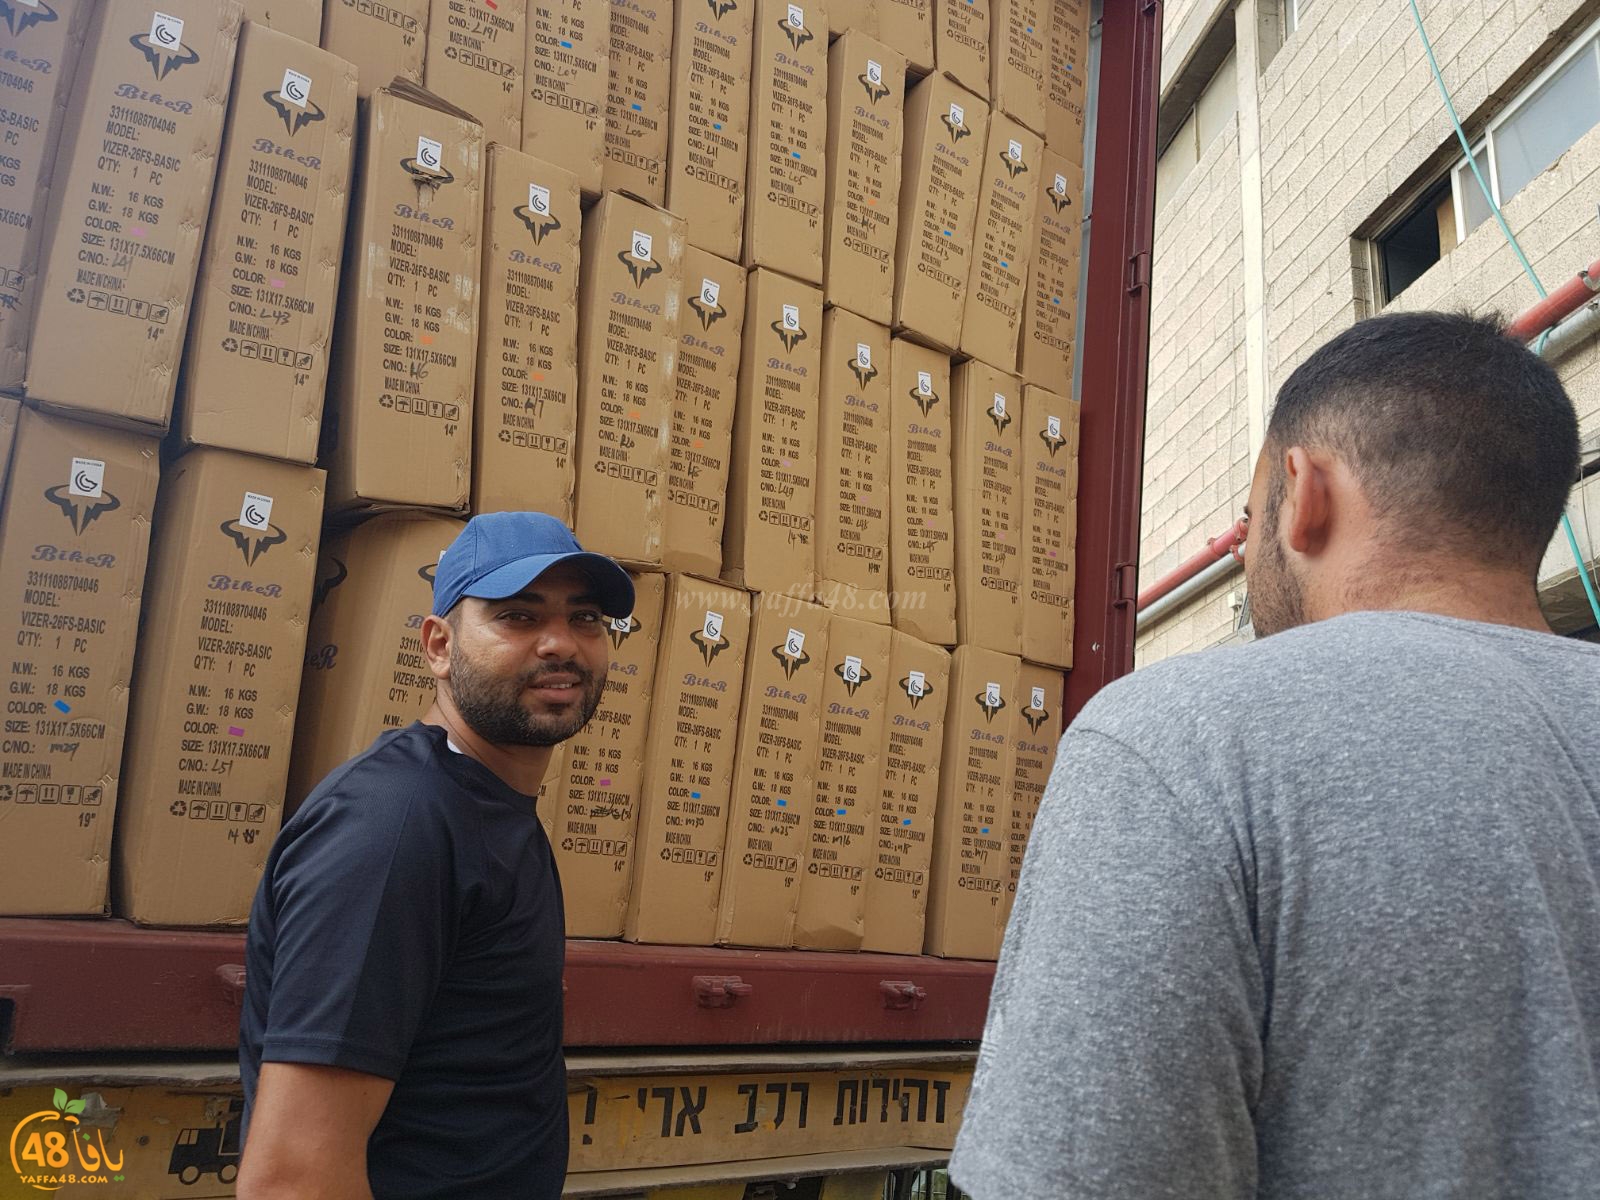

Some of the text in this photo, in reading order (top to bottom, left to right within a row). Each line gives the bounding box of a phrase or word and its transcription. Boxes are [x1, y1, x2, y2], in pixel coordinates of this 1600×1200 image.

[449, 1, 466, 14] SIZE:
[571, 17, 585, 29] KGS
[535, 33, 560, 48] COLOR:
[569, 29, 583, 41] KGS
[535, 46, 551, 57] SIZE:
[115, 84, 194, 116] BikeR
[5, 130, 19, 146] PC
[106, 120, 140, 141] MODEL:
[103, 139, 181, 172] VIZER-26FS-BASIC
[252, 138, 322, 171] BikeR
[149, 171, 162, 186] PC
[247, 174, 277, 195] MODEL:
[128, 191, 139, 203] 16
[143, 194, 164, 209] KGS
[121, 206, 133, 218] 18
[138, 210, 159, 225] KGS
[245, 192, 314, 225] VIZER-26FS-BASIC
[85, 216, 122, 233] COLOR:
[288, 224, 298, 239] PC
[81, 233, 175, 265] SIZE: 131X17.5X66CM
[270, 244, 279, 255] 16
[284, 247, 301, 261] KGS
[265, 259, 275, 270] 18
[280, 262, 298, 276] KGS
[233, 268, 266, 285] COLOR:
[429, 284, 437, 297] PC
[231, 284, 314, 315] SIZE: 131X17.5X66CM
[426, 306, 441, 318] KGS
[147, 326, 164, 341] 14"
[424, 320, 439, 333] KGS
[385, 328, 412, 342] COLOR:
[384, 343, 402, 355] SIZE:
[540, 345, 553, 356] KGS
[294, 373, 309, 386] 14"
[502, 366, 528, 380] COLOR:
[502, 381, 518, 392] SIZE:
[445, 424, 457, 437] 14"
[31, 545, 116, 569] BikeR
[208, 575, 282, 598] BikeR
[24, 589, 61, 607] MODEL:
[22, 611, 106, 634] VIZER-26FS-BASIC
[201, 616, 233, 634] MODEL:
[56, 636, 61, 649] 1
[74, 638, 87, 653] PC
[199, 636, 272, 659] VIZER-26FS-BASIC
[228, 660, 232, 672] 1
[244, 663, 255, 677] PC
[396, 652, 425, 669] MODEL:
[52, 665, 63, 676] 16
[69, 666, 90, 678] KGS
[46, 684, 58, 695] 18
[64, 684, 86, 697] KGS
[224, 688, 234, 699] 16
[238, 689, 258, 701] KGS
[8, 701, 47, 714] COLOR:
[218, 705, 229, 717] 18
[234, 706, 254, 719] KGS
[5, 721, 106, 739] SIZE: 131X17.5X66CM
[184, 721, 219, 734] COLOR:
[181, 740, 270, 759] SIZE: 131X17.5X66CM
[608, 748, 622, 760] KGS
[570, 774, 596, 786] COLOR:
[568, 790, 586, 799] SIZE:
[79, 812, 96, 828] 19"
[734, 1081, 809, 1134] רכב
[833, 1079, 951, 1126] זהירות
